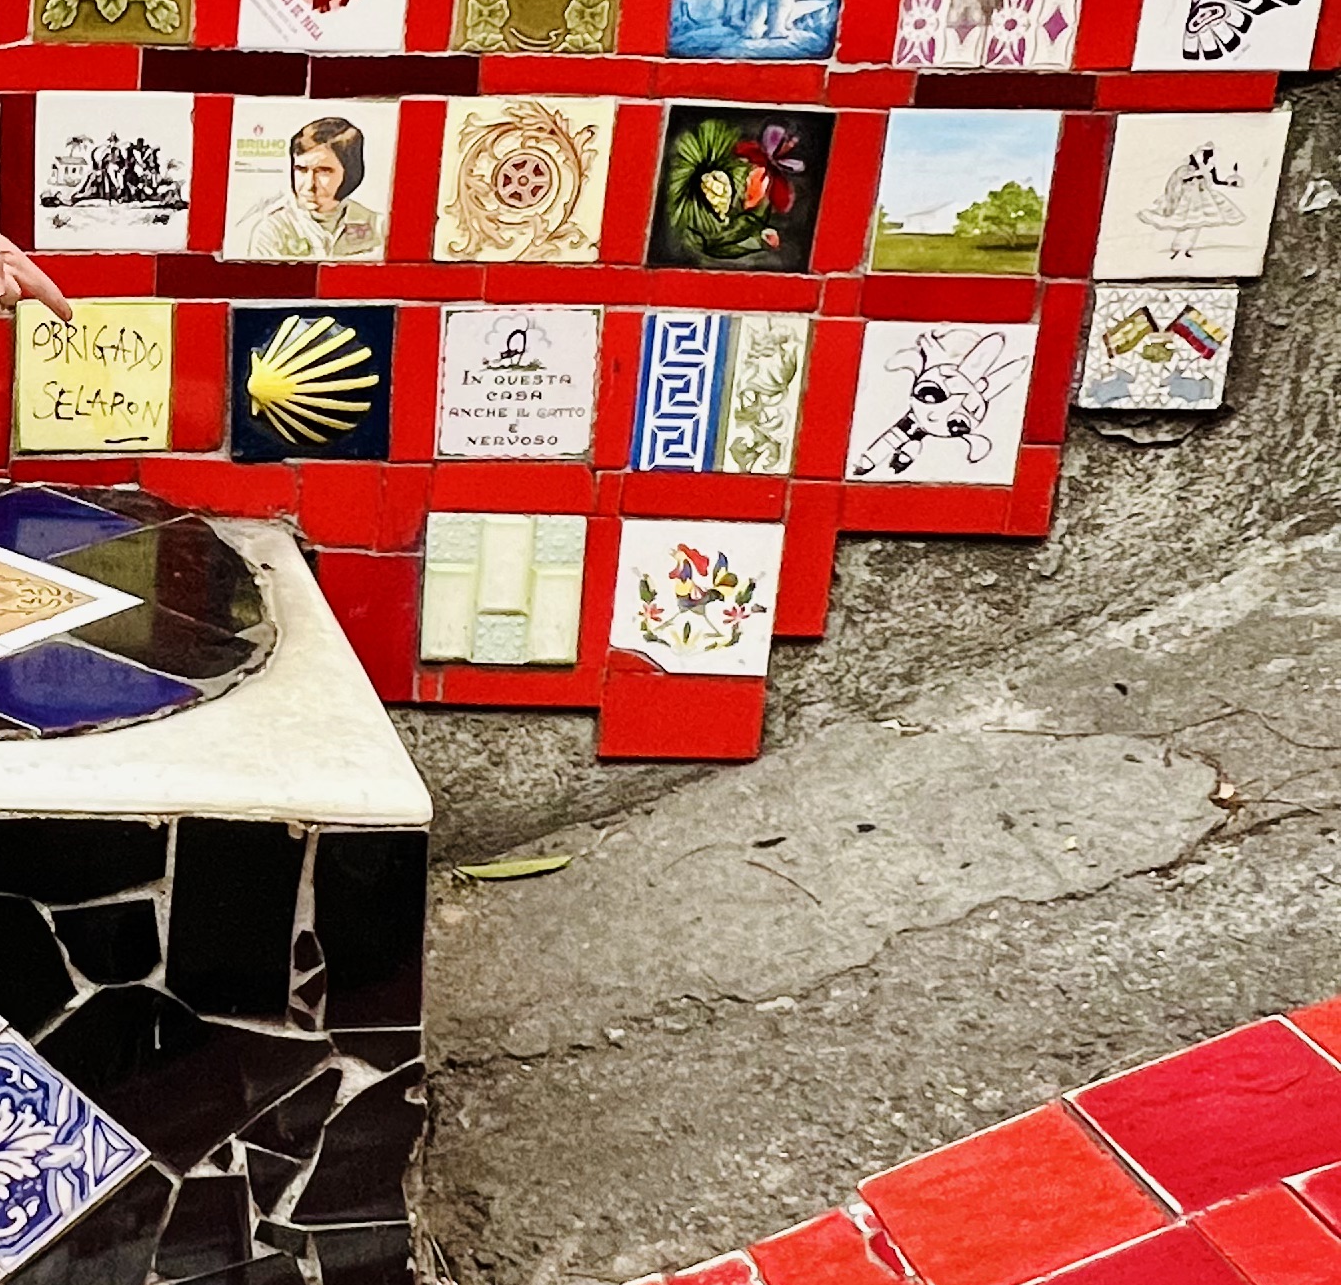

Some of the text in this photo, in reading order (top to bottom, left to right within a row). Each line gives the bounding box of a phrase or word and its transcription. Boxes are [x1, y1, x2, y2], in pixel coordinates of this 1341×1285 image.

[32, 320, 164, 372] OBRIGADO
[494, 375, 572, 386] QUESTA
[486, 390, 543, 402] CASA
[32, 380, 164, 428] SELARON
[448, 407, 587, 418] ANCHE IL GATTO
[466, 435, 559, 446] NERVOSO
